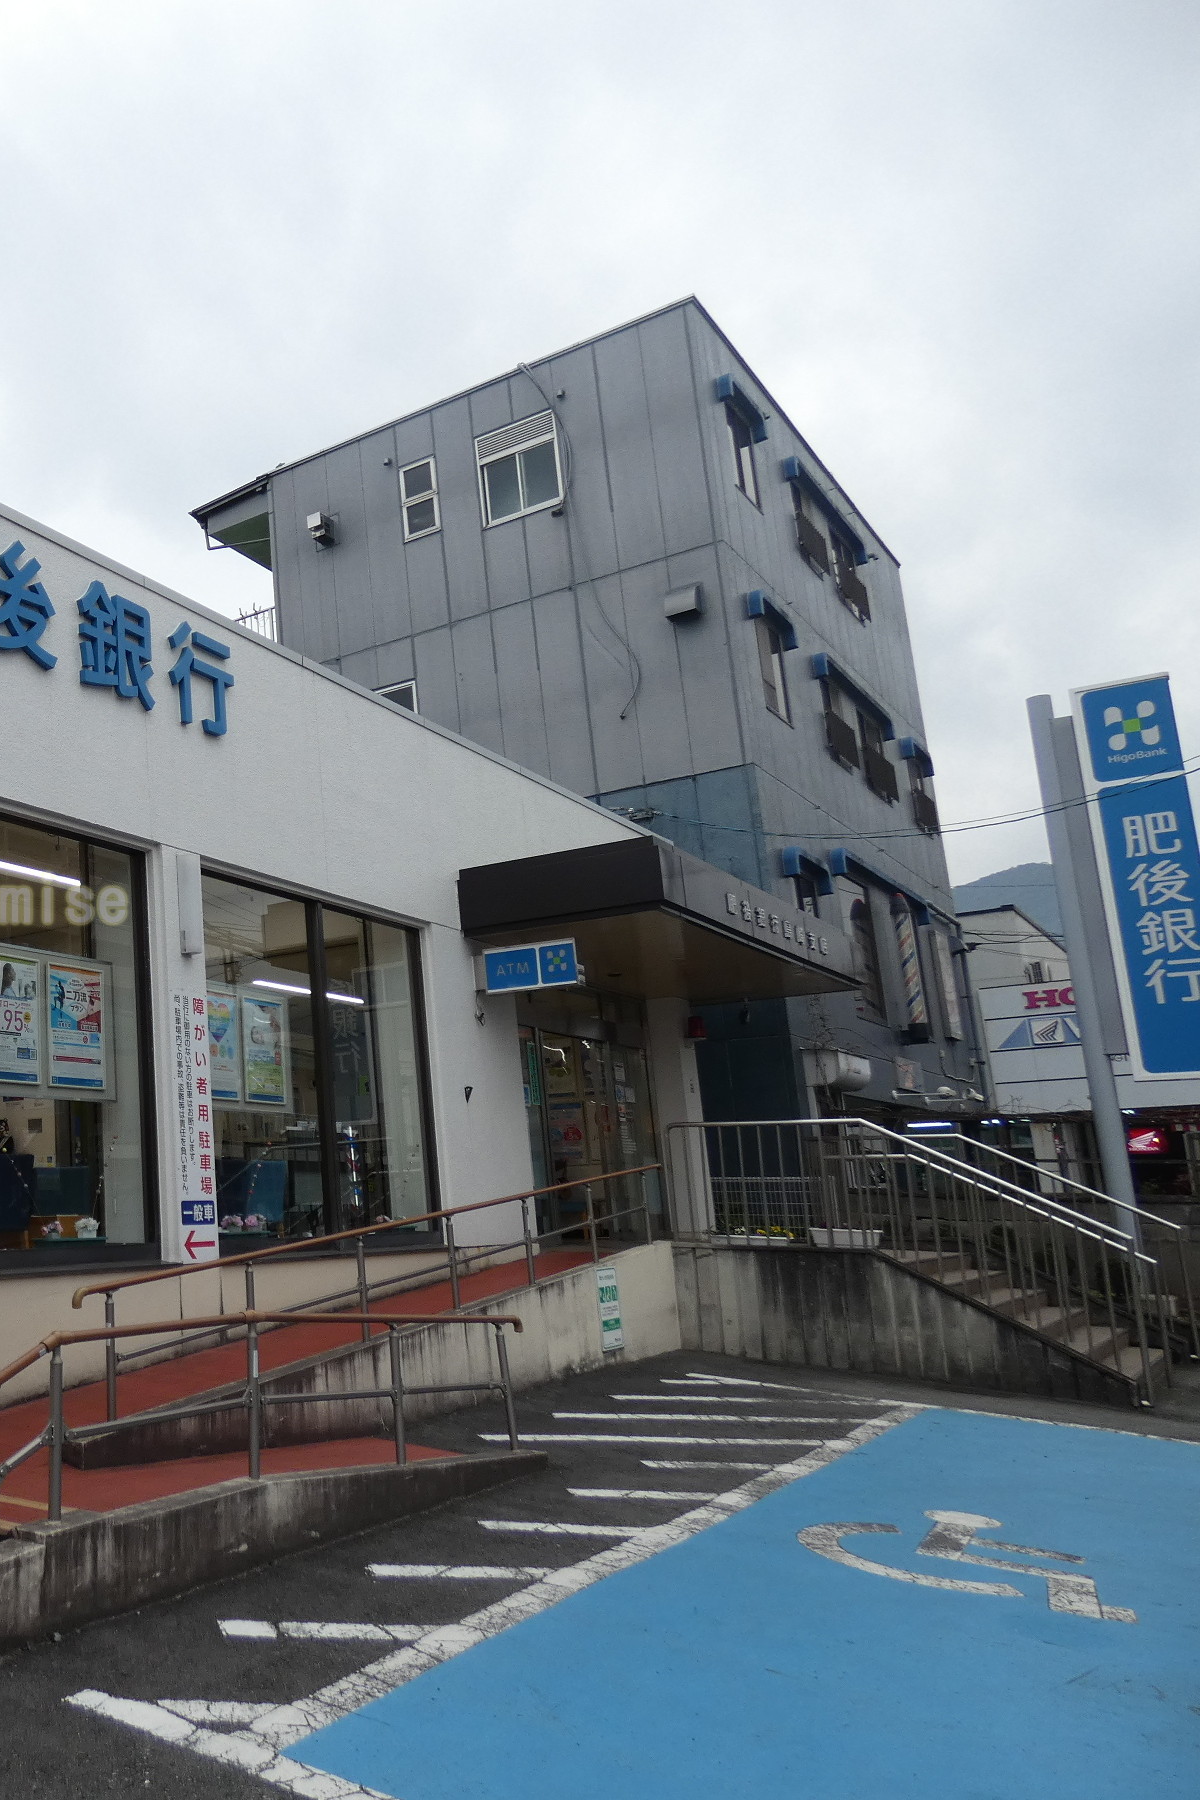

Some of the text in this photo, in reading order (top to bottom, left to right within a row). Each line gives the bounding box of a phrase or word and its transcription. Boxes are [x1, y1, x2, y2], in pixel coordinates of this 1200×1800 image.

[1107, 747, 1169, 764] HigoBank
[1122, 810, 1200, 1005] 肥後銀行
[496, 961, 530, 977] ATM
[65, 990, 88, 1003] 二刀流
[192, 997, 213, 1195] 障がい者用駐車場
[183, 1203, 214, 1222] 一般車
